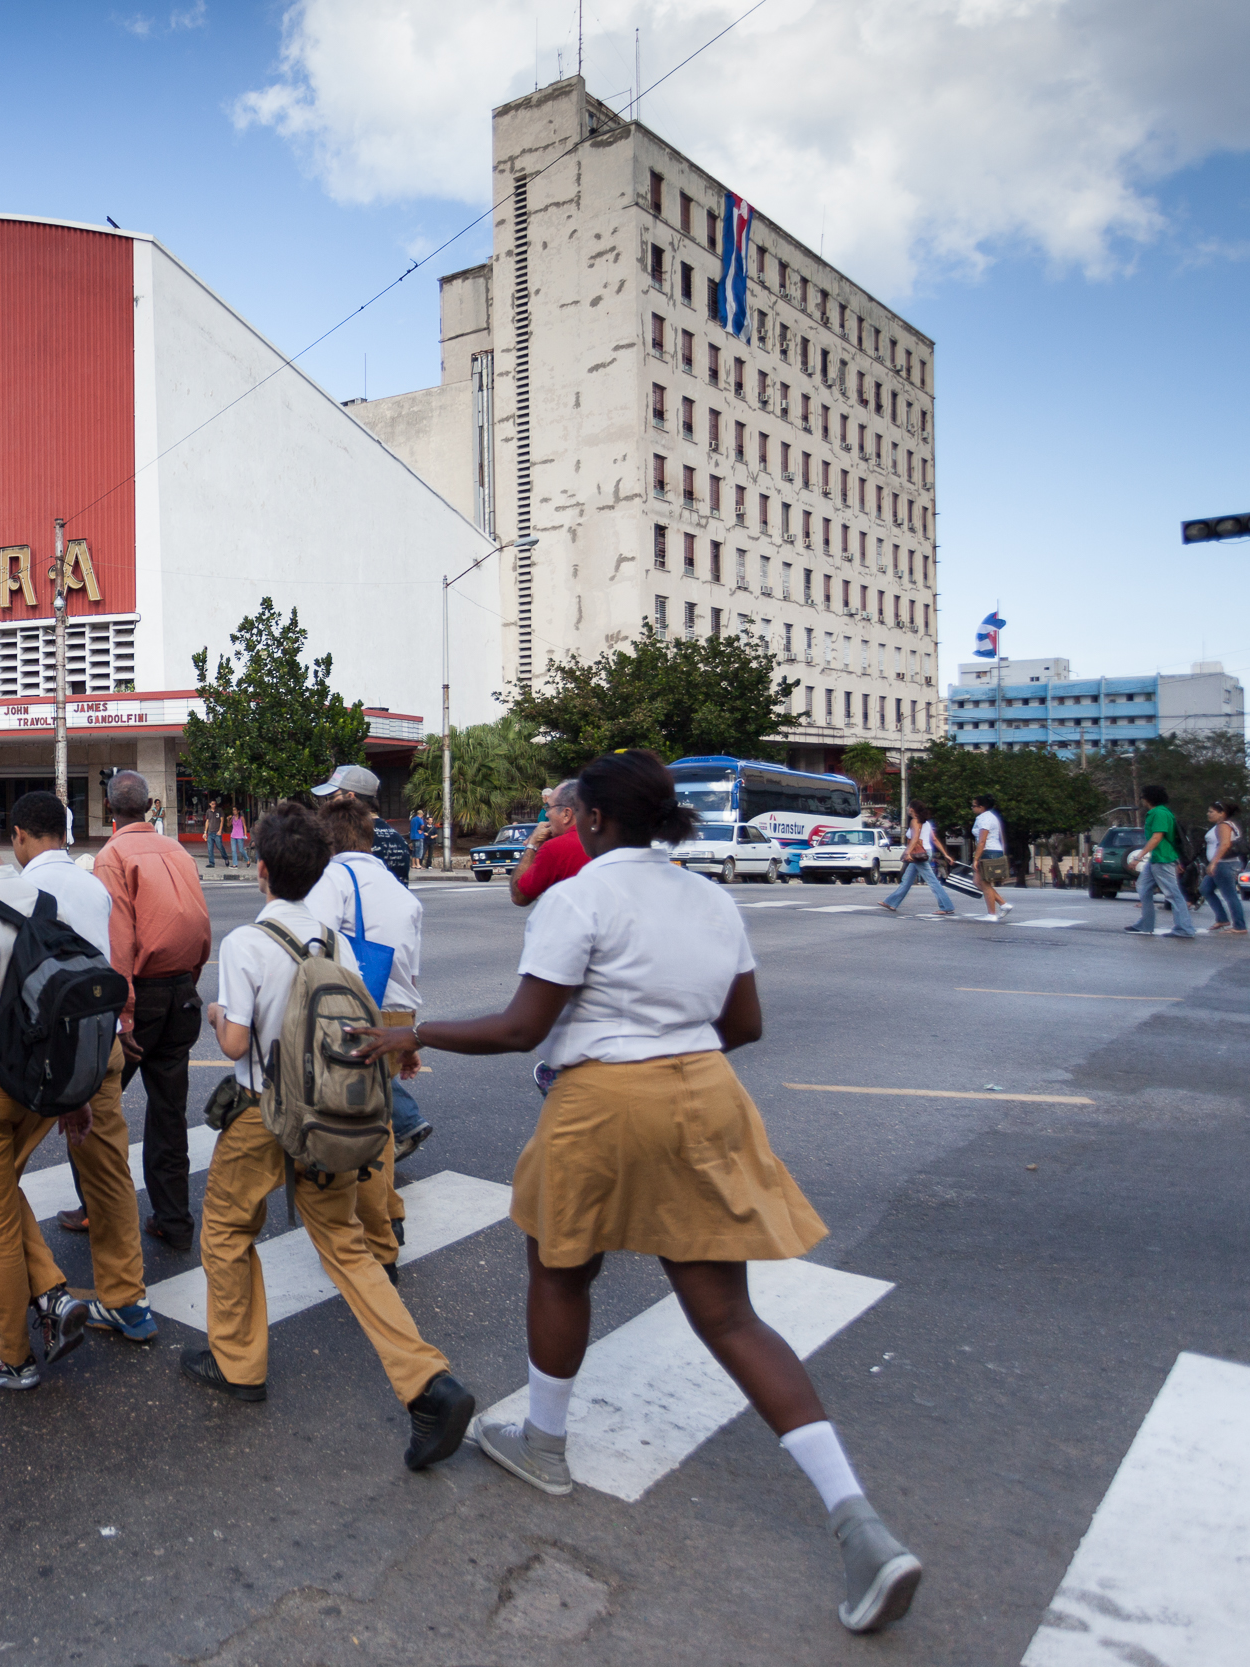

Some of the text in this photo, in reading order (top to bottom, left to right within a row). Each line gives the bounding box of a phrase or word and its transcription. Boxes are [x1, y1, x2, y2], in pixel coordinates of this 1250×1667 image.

[4, 706, 29, 716] JOHN
[74, 703, 108, 713] JAMES
[17, 717, 57, 727] TRAVOLT
[87, 713, 148, 724] GANDOLFINI
